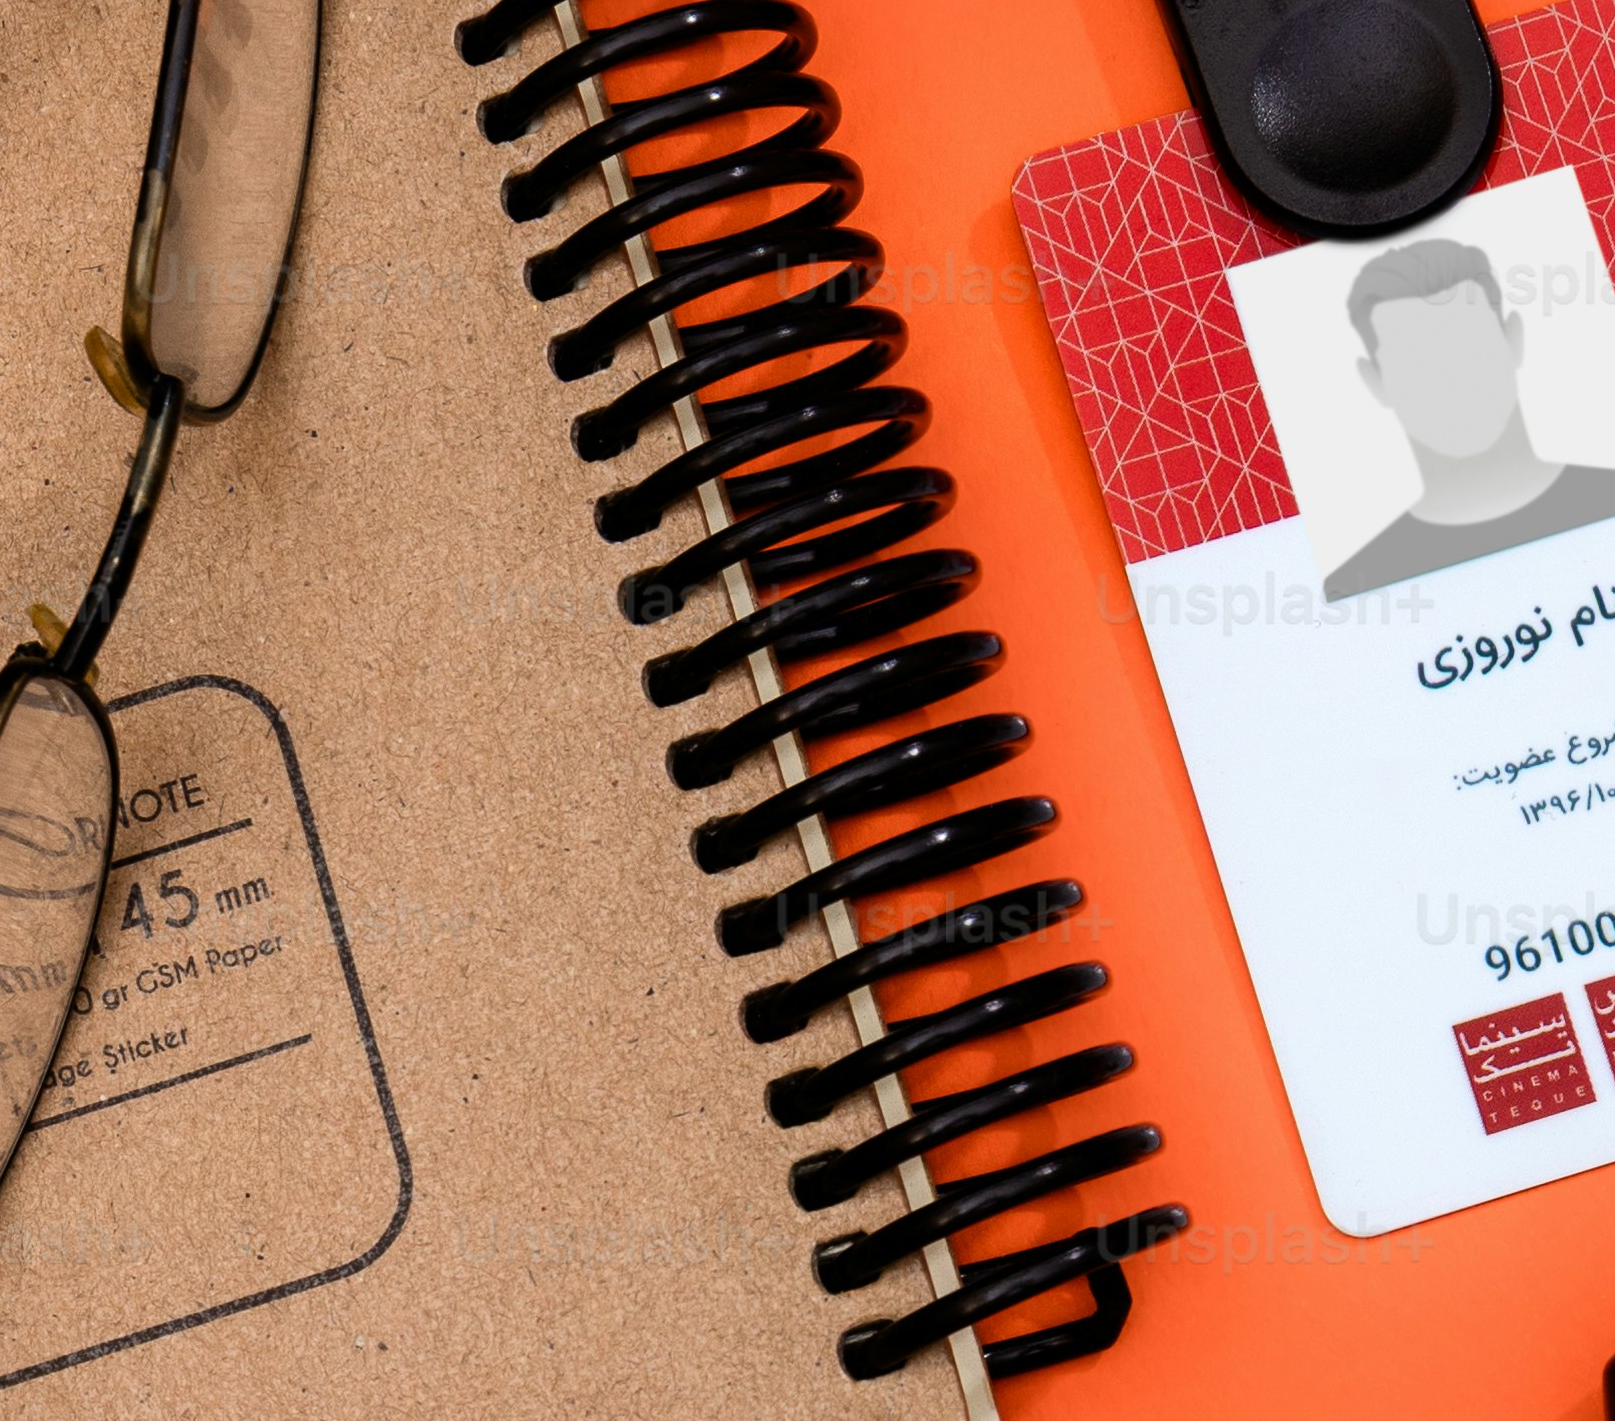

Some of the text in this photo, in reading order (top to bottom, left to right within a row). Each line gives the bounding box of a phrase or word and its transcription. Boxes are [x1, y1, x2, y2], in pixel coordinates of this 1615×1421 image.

[1416, 606, 1553, 689] نوروزی
[120, 867, 272, 941] 45 mm
[101, 984, 130, 1012] gr
[136, 955, 200, 995] GSM
[205, 934, 284, 974] Paper
[102, 1026, 188, 1070] Sticker
[1482, 1064, 1579, 1102] CINEMA
